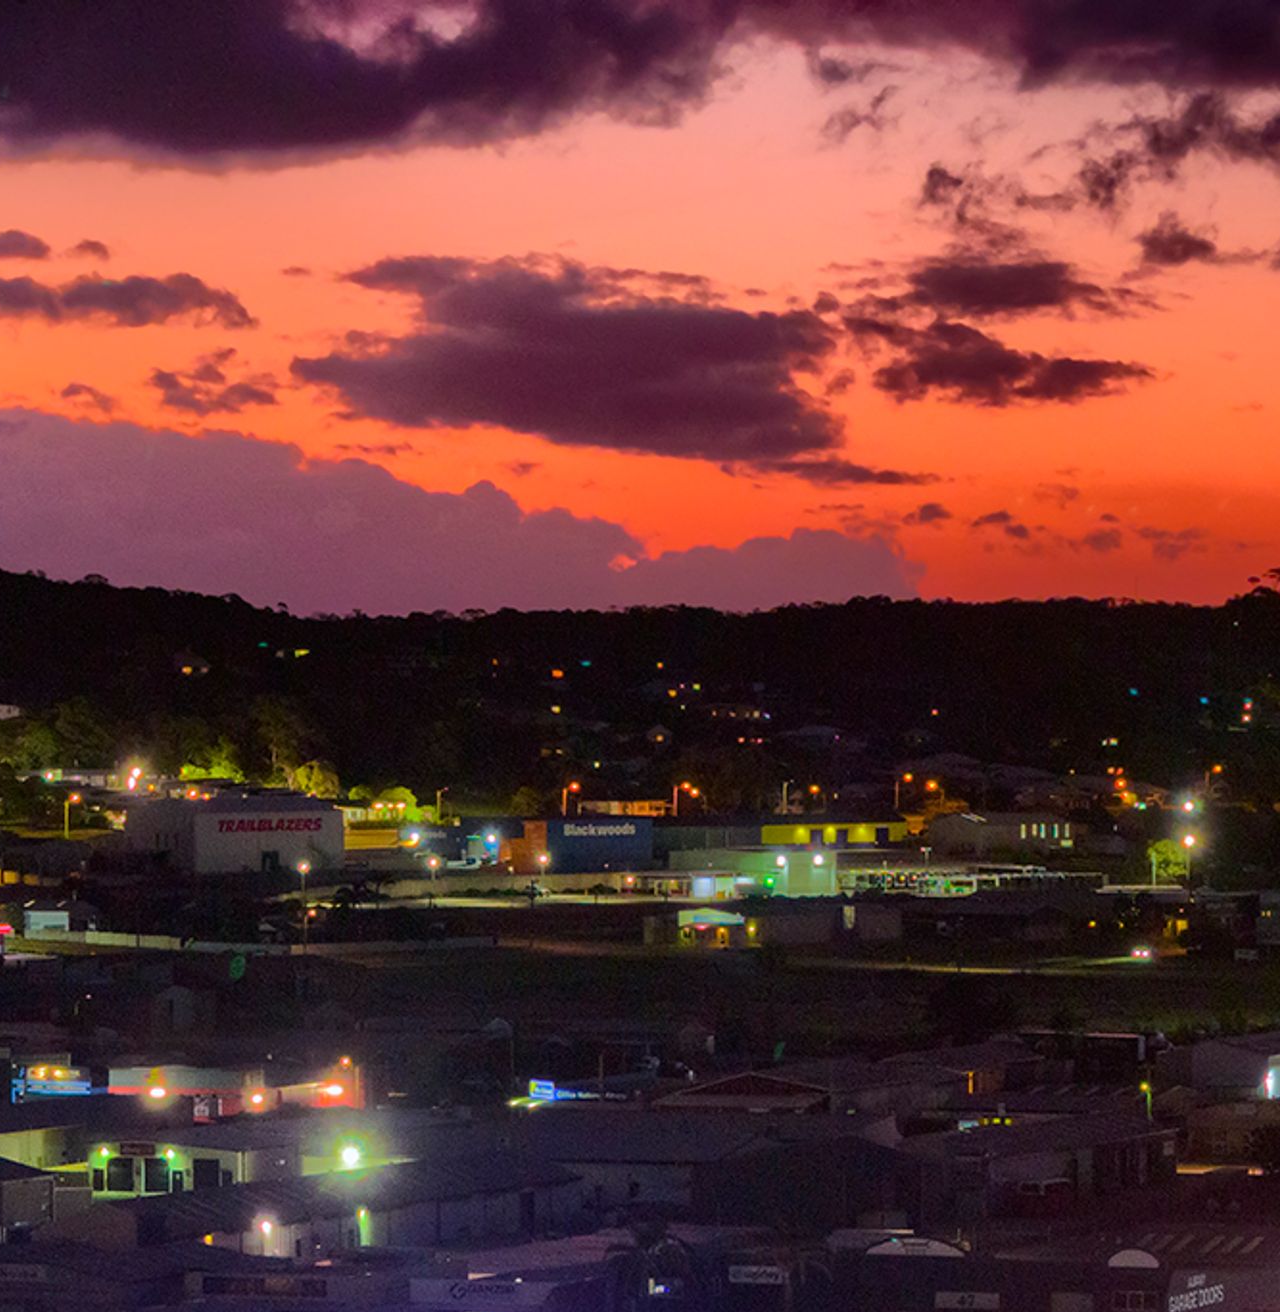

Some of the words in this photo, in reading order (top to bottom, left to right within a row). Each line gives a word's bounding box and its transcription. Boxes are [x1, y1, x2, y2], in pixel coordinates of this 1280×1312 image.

[218, 817, 322, 833] TRAILBLAZERS
[563, 823, 636, 837] Blackwoods
[1198, 1283, 1224, 1307] DOORS
